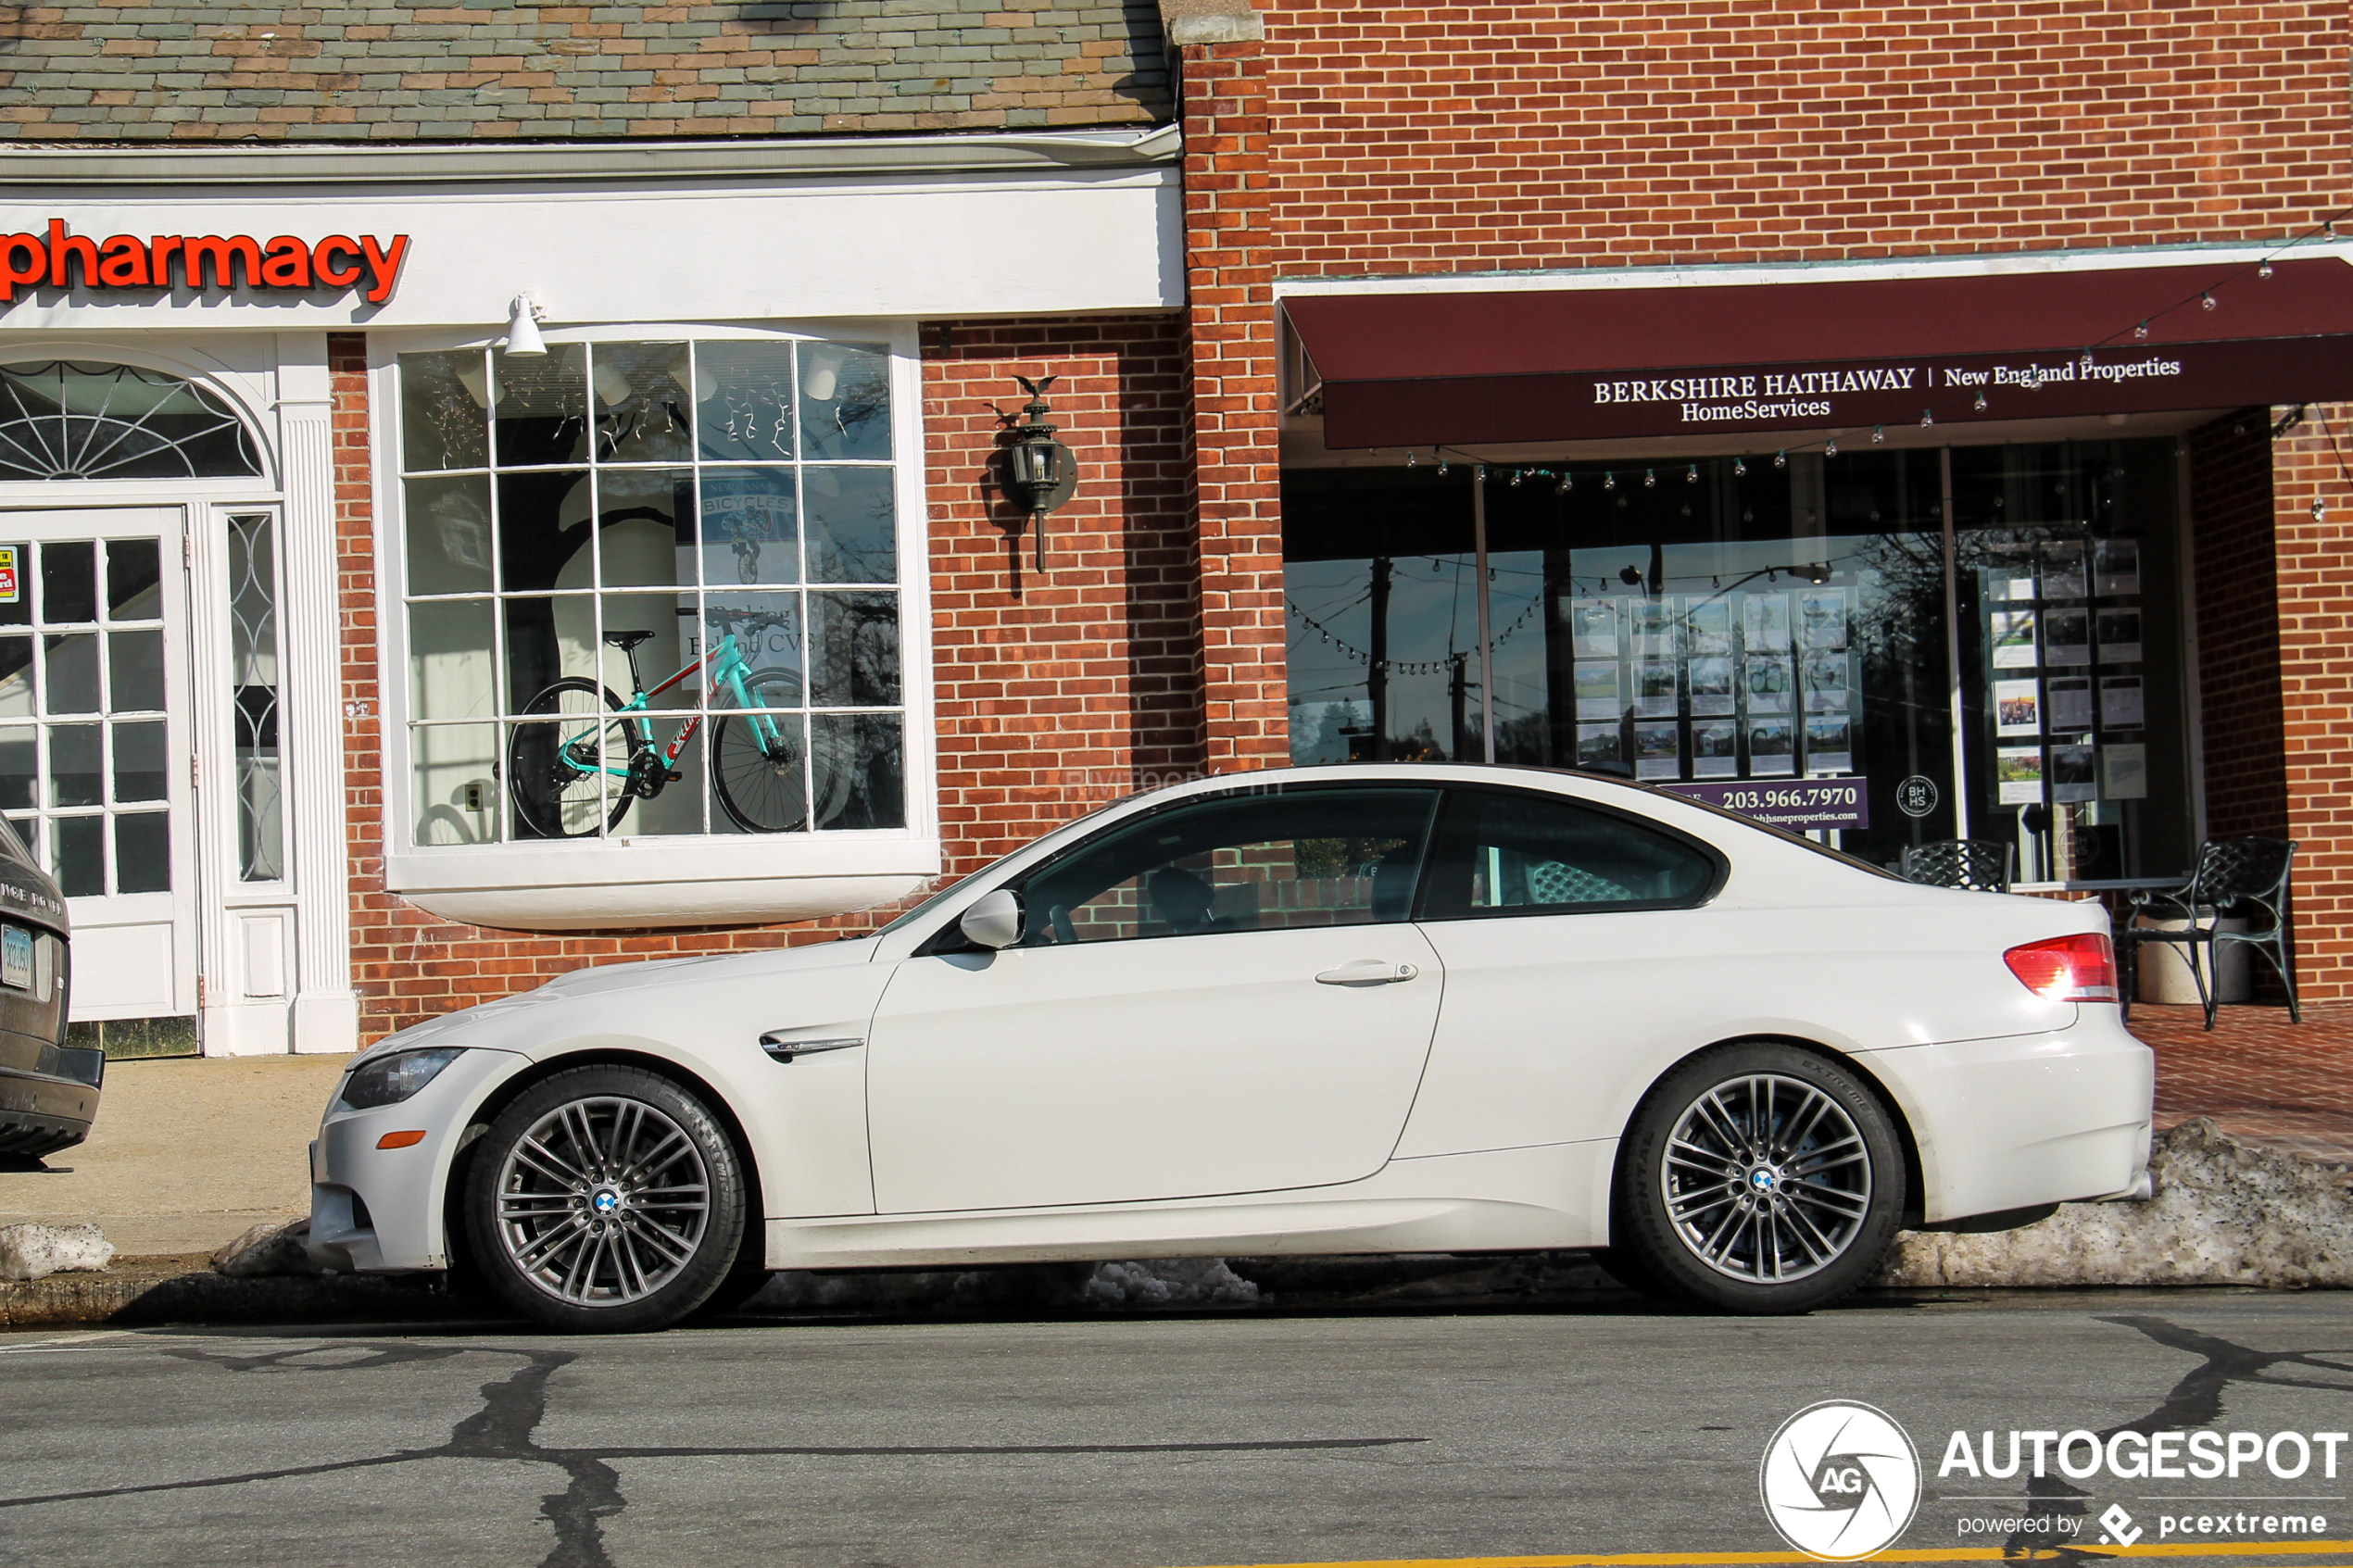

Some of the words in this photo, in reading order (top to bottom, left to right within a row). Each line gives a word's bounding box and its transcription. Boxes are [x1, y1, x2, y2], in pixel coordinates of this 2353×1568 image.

[0, 218, 410, 302] pharmacy
[1944, 368, 1988, 387] New
[1994, 362, 2075, 388] England
[2079, 357, 2181, 384] Properties
[1593, 376, 1756, 404] BERKSHIRE
[1764, 367, 1916, 396] HATHAWAY
[1681, 398, 1831, 421] HomeServices
[704, 496, 787, 512] BICYCLES
[1722, 786, 1856, 809] 203.966.7970
[1908, 786, 1925, 797] BH
[1909, 797, 1926, 807] HS
[1801, 1060, 1871, 1112] EXTREME
